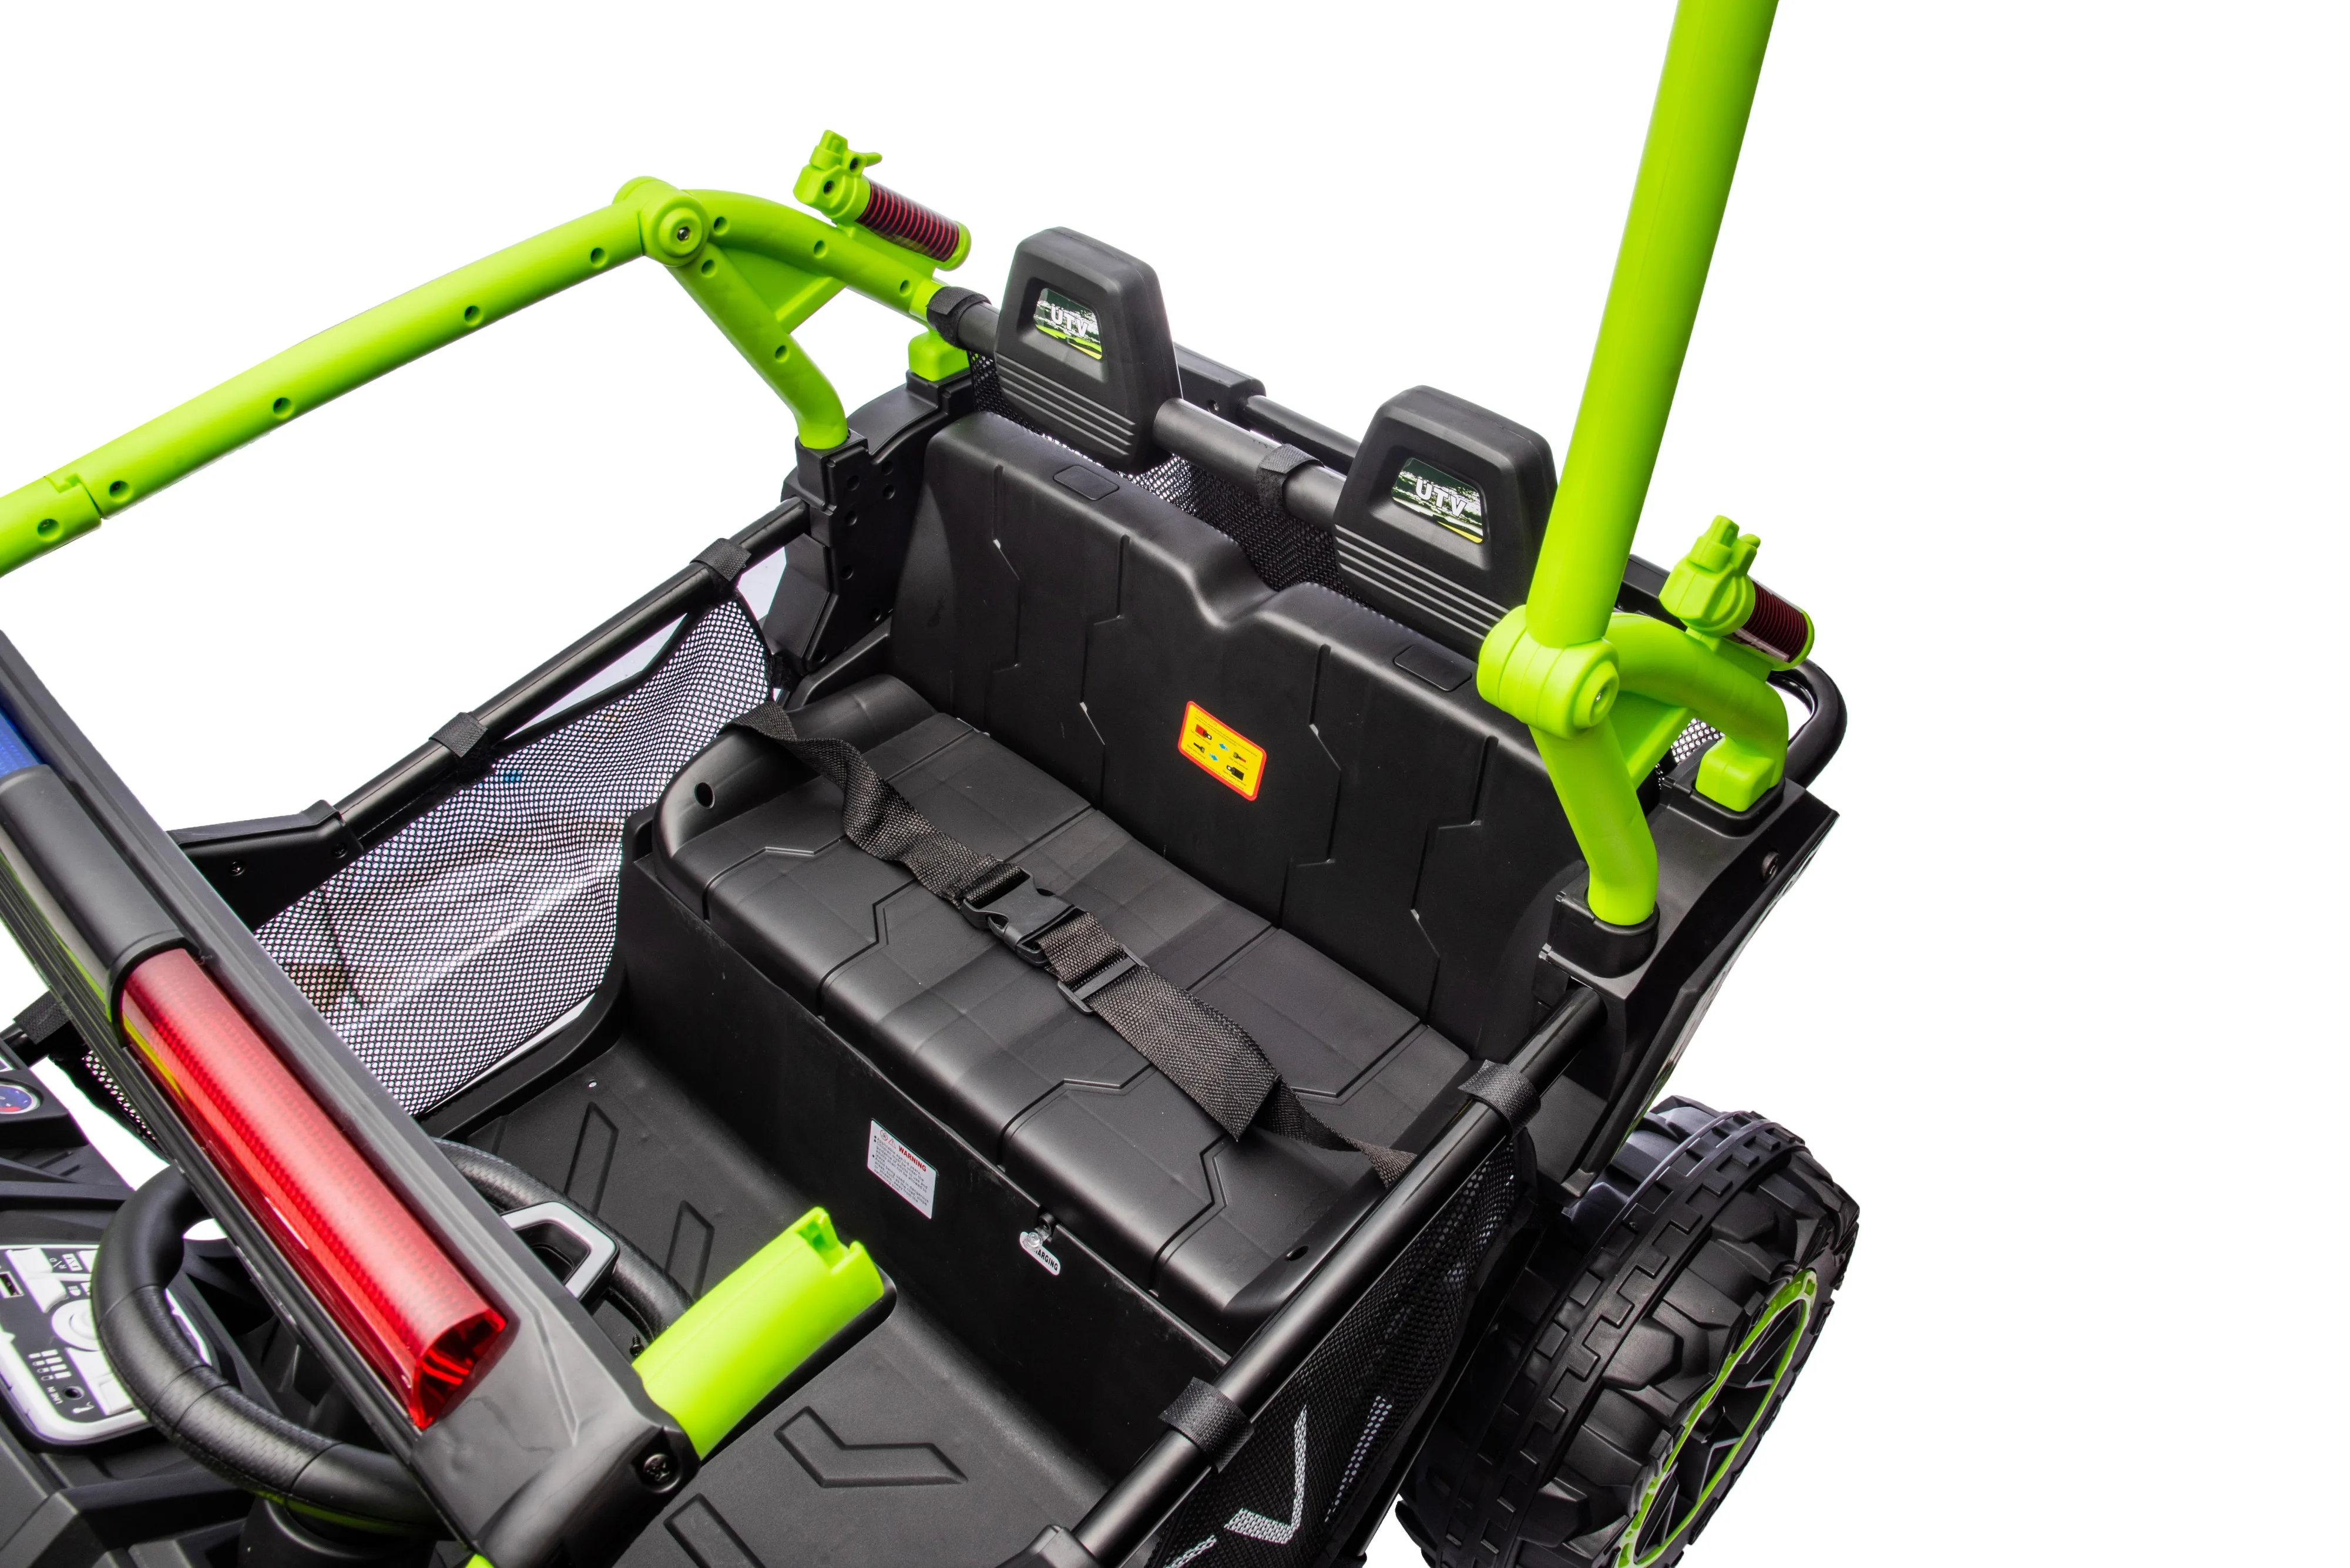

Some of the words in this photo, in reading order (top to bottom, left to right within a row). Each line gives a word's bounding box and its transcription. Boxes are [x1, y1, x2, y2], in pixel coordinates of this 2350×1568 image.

[1051, 305, 1089, 338] UTV
[1415, 478, 1467, 518] UTV
[899, 1146, 926, 1171] WARNING
[909, 1186, 929, 1203] dangerous
[1034, 1248, 1058, 1271] ARGING
